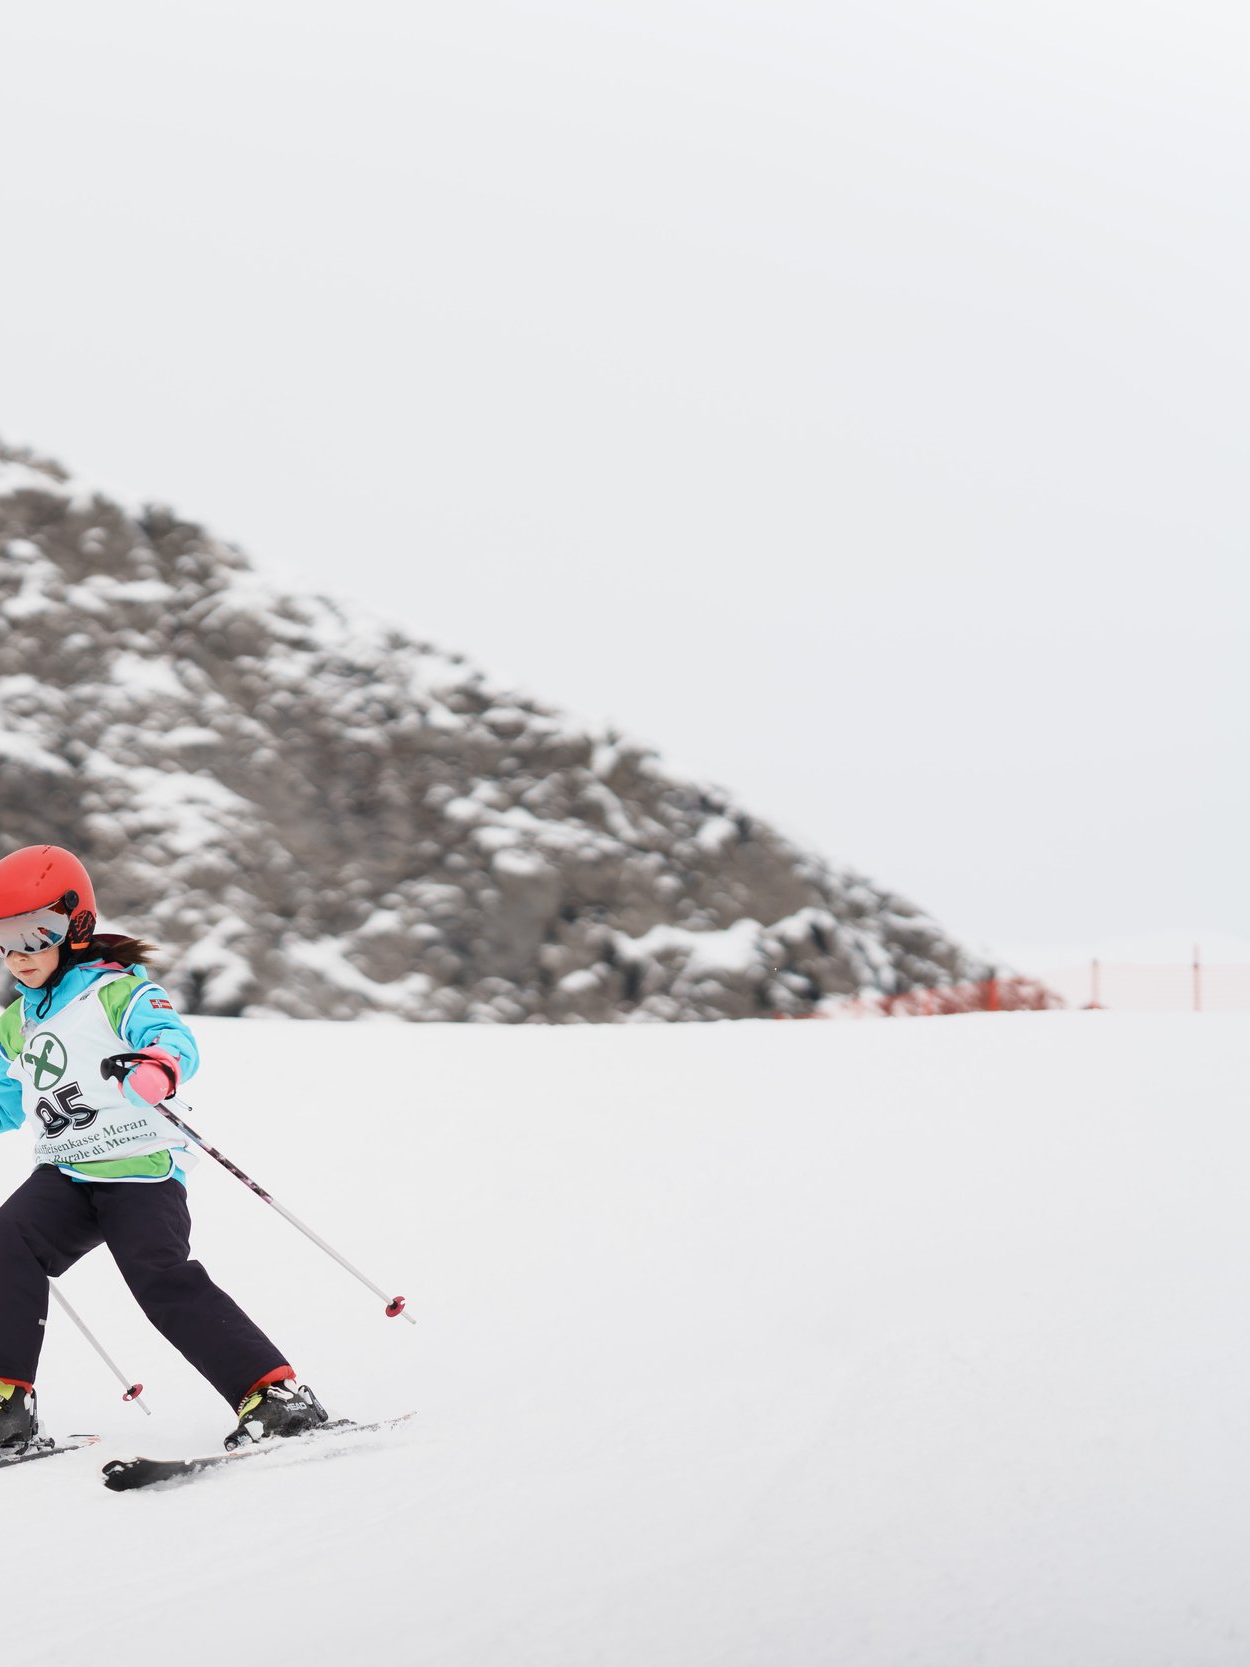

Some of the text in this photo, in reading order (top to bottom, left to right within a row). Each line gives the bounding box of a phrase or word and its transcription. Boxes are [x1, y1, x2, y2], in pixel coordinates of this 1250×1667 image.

[102, 1118, 148, 1139] Meran
[92, 1143, 105, 1156] di
[283, 1402, 308, 1412] HEAD
